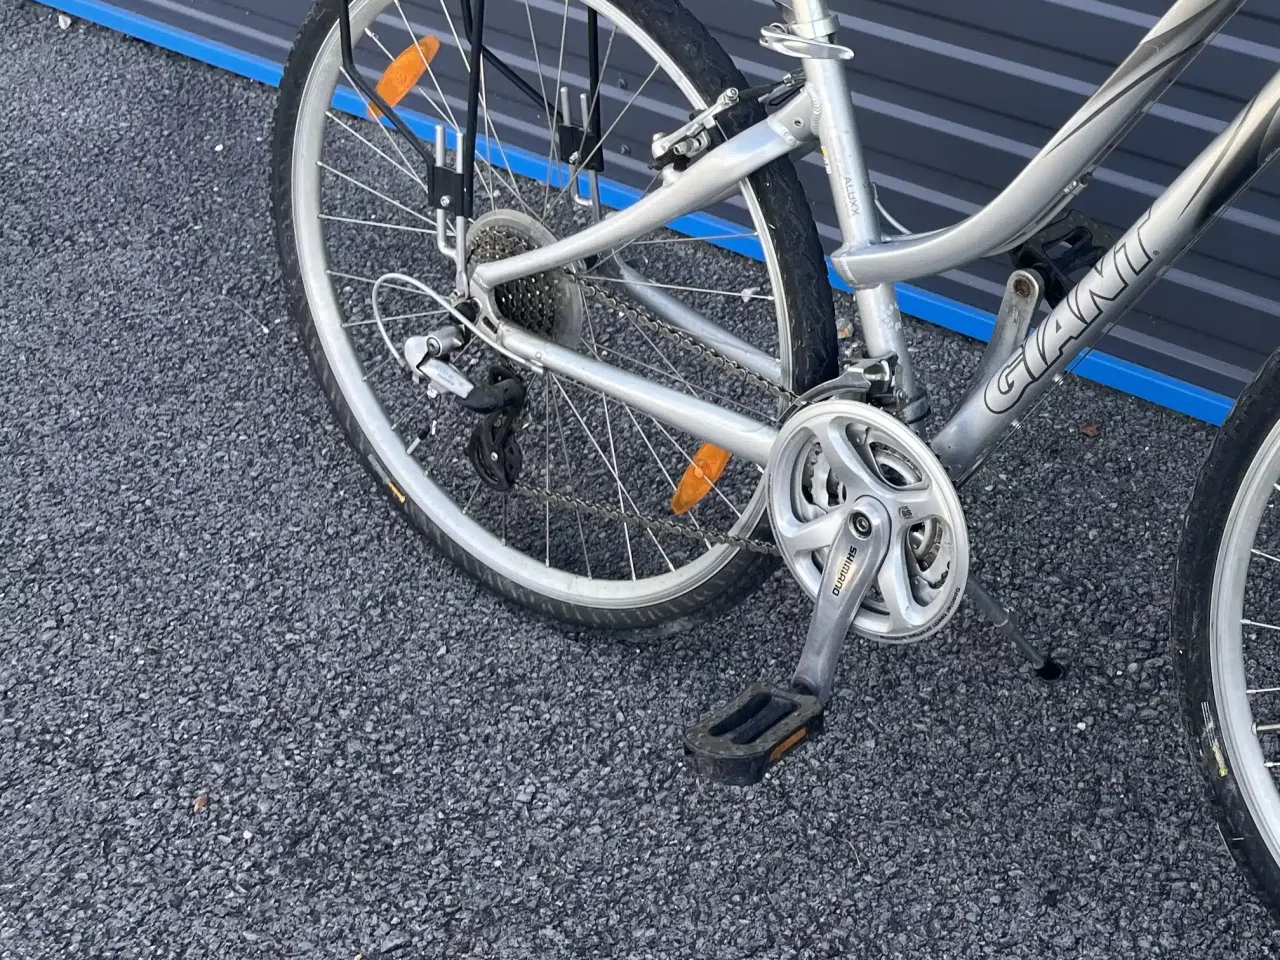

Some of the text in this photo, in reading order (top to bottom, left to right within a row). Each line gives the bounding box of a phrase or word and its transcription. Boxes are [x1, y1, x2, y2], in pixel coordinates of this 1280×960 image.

[844, 176, 860, 217] ALUXX
[984, 203, 1153, 415] GIANT
[832, 545, 857, 597] SHIMANO
